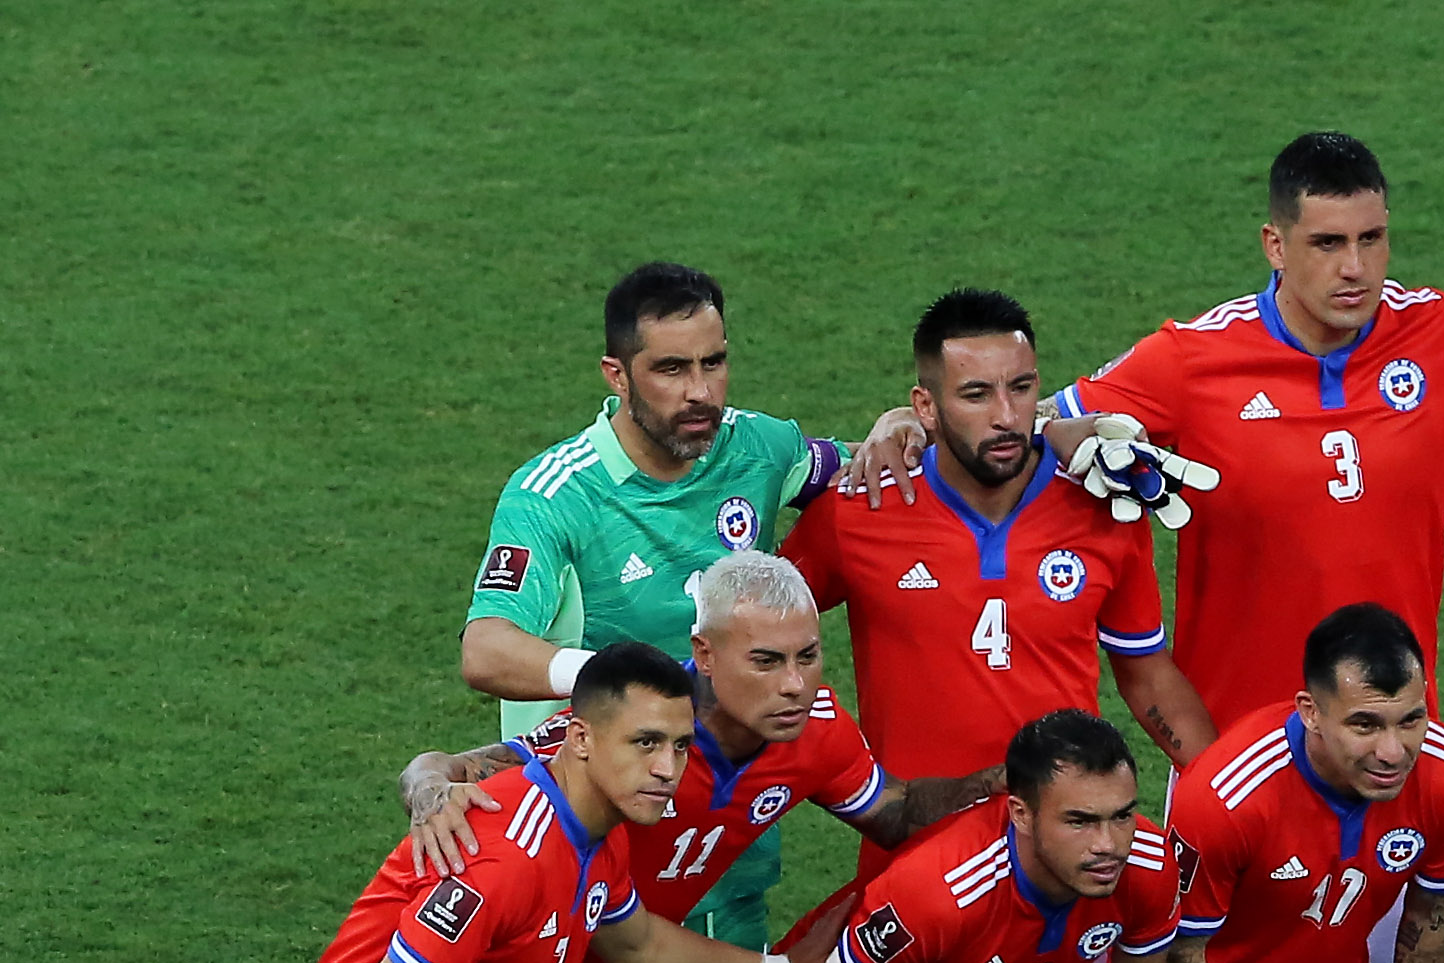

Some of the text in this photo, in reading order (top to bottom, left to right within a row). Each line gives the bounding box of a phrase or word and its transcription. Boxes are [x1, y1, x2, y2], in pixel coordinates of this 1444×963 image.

[1239, 408, 1281, 420] adidas
[1321, 430, 1363, 504] 3
[620, 566, 653, 584] adidas
[898, 579, 939, 589] adidas
[972, 598, 1010, 670] 4
[657, 825, 725, 879] 11
[1270, 865, 1309, 876] adidas
[1300, 867, 1367, 930] 17
